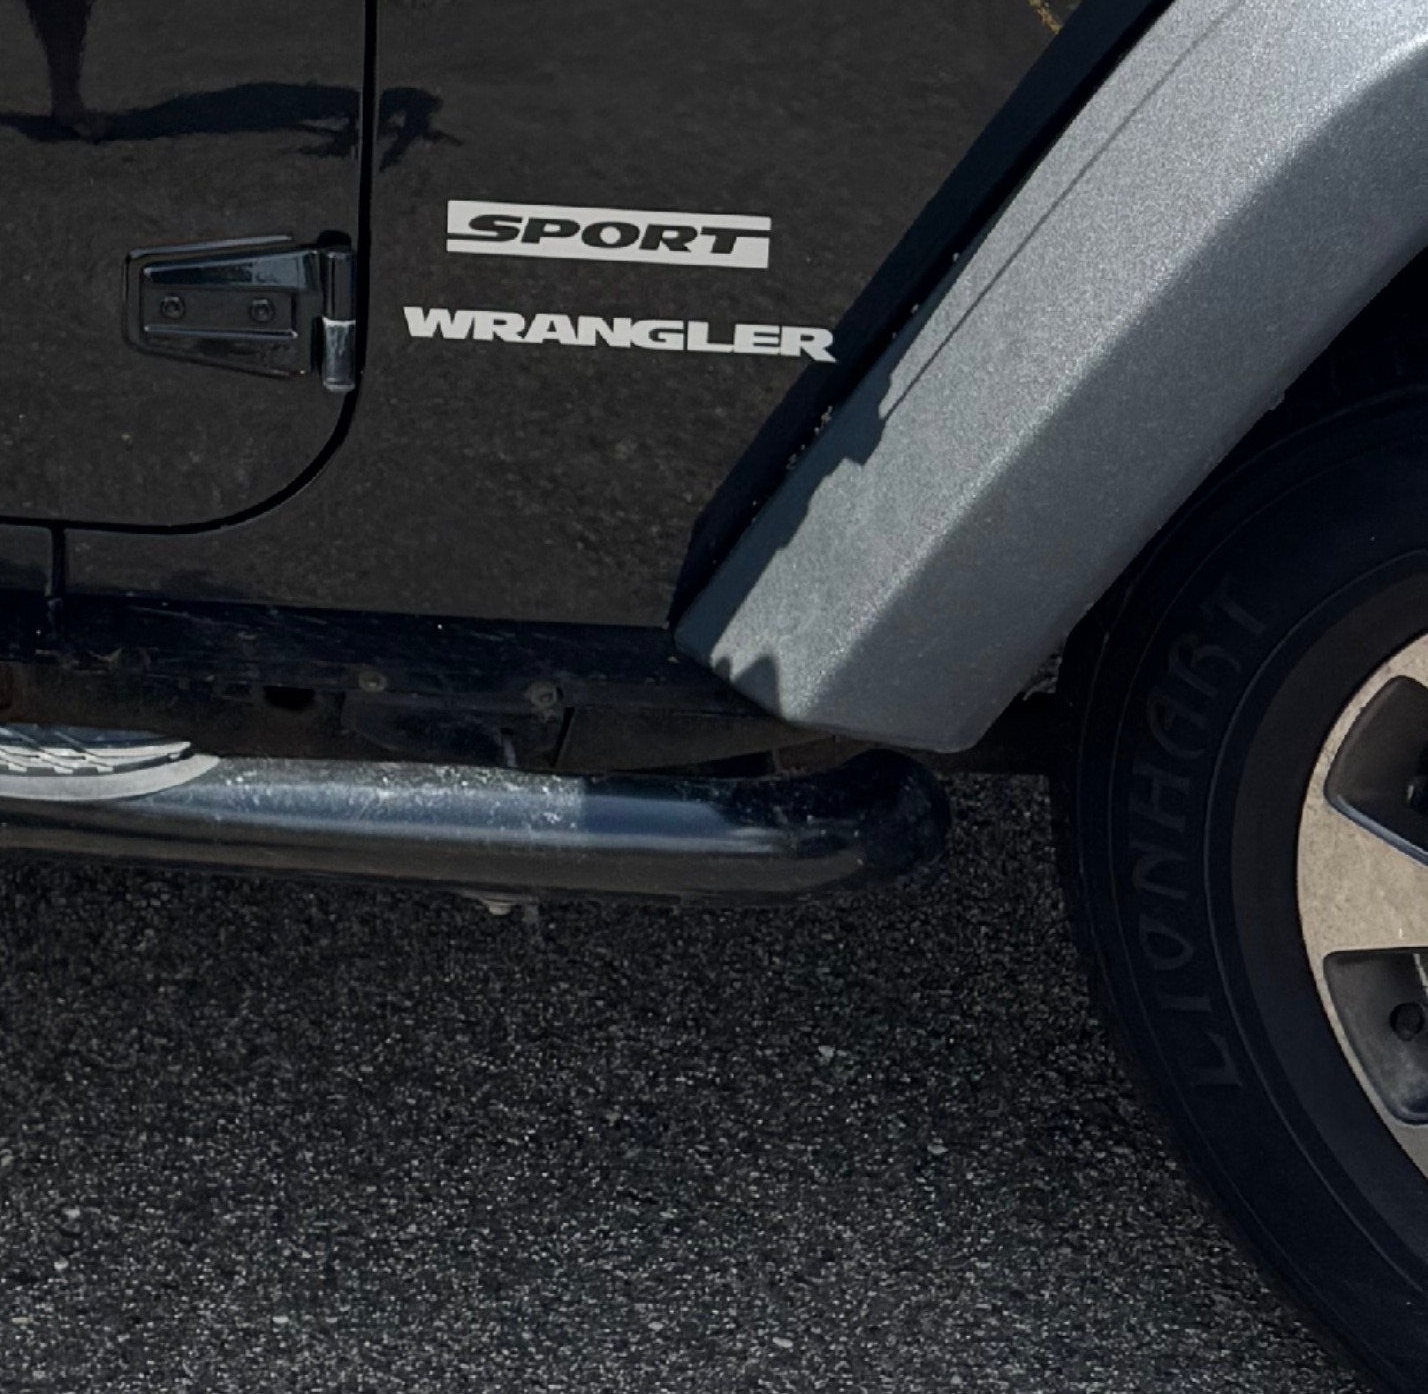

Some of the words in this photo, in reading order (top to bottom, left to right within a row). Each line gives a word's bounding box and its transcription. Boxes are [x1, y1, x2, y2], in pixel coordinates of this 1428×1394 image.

[447, 211, 771, 257] SPORT
[403, 306, 837, 363] WRANGLER
[1128, 571, 1268, 1088] LIONHART
